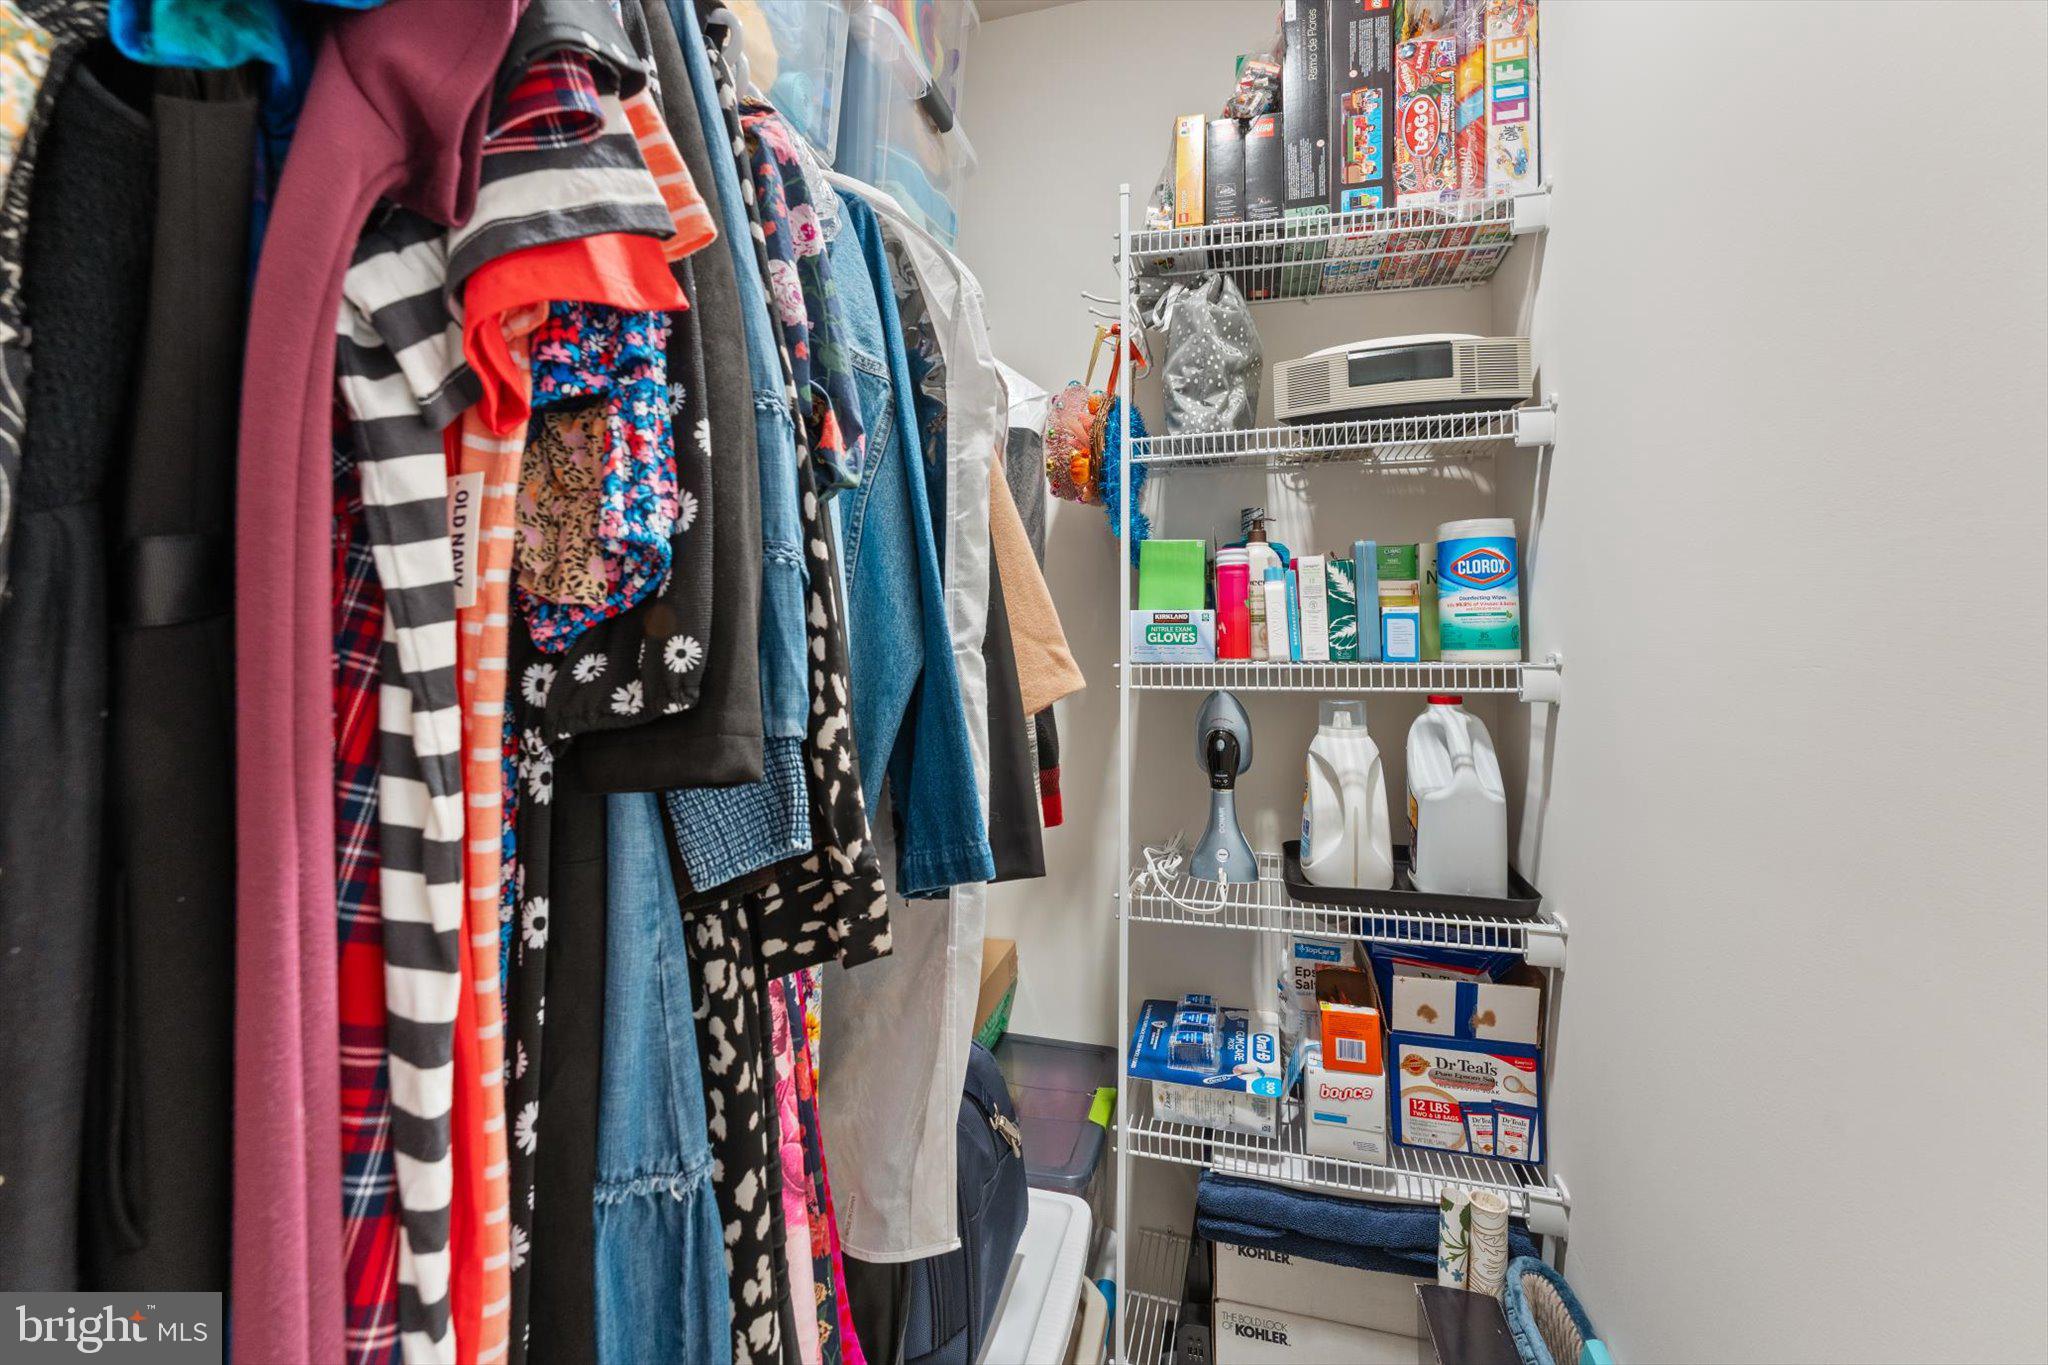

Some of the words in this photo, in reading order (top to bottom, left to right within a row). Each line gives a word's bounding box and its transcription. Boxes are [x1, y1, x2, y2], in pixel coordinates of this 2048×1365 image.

[1306, 8, 1318, 37] Flores
[1307, 38, 1318, 52] de
[1307, 53, 1318, 81] Ramo
[1494, 39, 1528, 123] LIFE
[1413, 100, 1429, 153] LOGO
[453, 490, 470, 528] OLD
[451, 533, 464, 589] NAVY
[1457, 559, 1506, 575] CLOROX
[1147, 632, 1197, 643] GLOVES
[1218, 807, 1226, 834] CONAIR
[1305, 946, 1336, 956] TopCare
[1295, 966, 1317, 979] Eps
[1295, 978, 1317, 991] Sal
[1234, 1044, 1244, 1062] CARE
[1255, 1034, 1271, 1063] Oral-B
[1434, 1056, 1457, 1071] Dr
[1457, 1058, 1498, 1077] Teal's
[1434, 1070, 1452, 1078] Pure
[1454, 1072, 1481, 1082] Epsom
[1482, 1075, 1499, 1087] Salt
[1319, 1083, 1374, 1102] bounce
[1411, 1099, 1426, 1112] 12
[1429, 1100, 1451, 1113] LBS
[1412, 1110, 1427, 1118] TWO
[1442, 1114, 1460, 1122] BAGS
[1471, 1116, 1480, 1124] Dr
[1222, 1311, 1238, 1321] THE
[1238, 1313, 1262, 1328] BOLD
[1263, 1319, 1289, 1332] LOOK
[1222, 1320, 1234, 1330] OF
